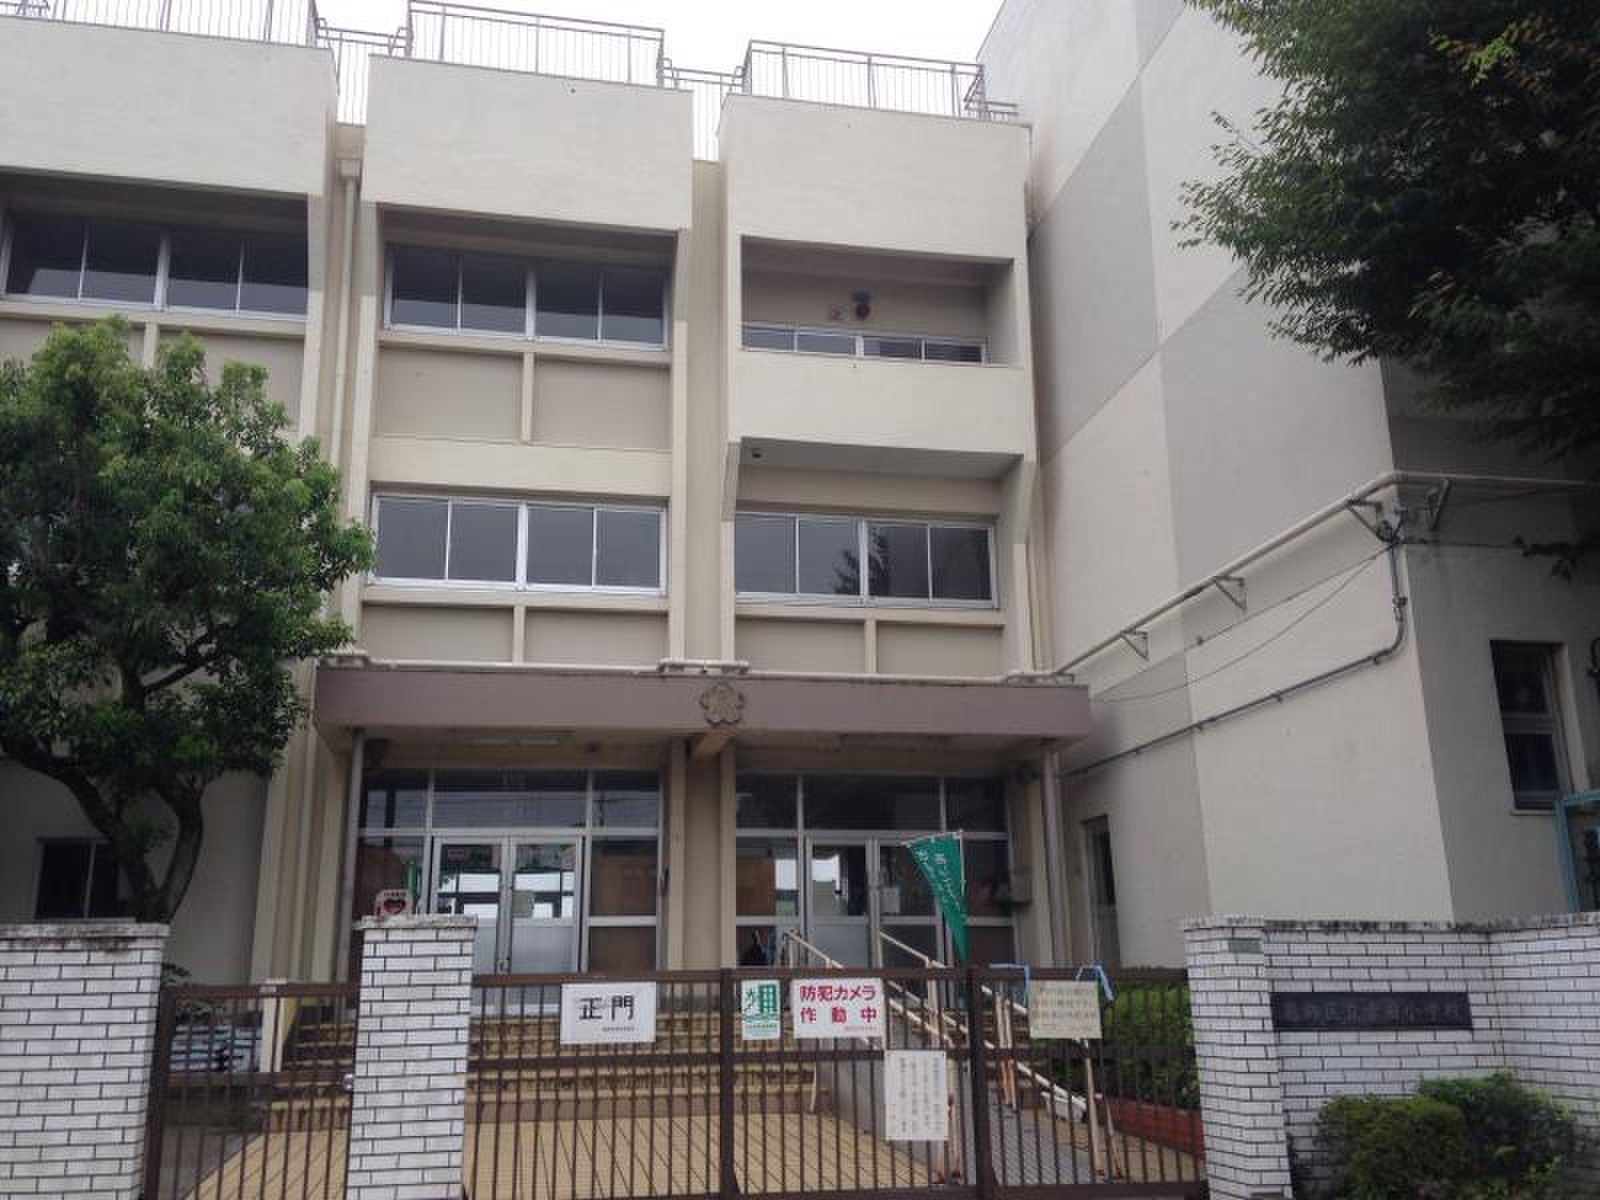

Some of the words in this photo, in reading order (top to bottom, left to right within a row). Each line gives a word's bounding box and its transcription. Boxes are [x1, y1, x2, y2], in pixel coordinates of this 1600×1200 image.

[799, 984, 877, 1002] 防犯カメラ
[579, 995, 635, 1021] 正門
